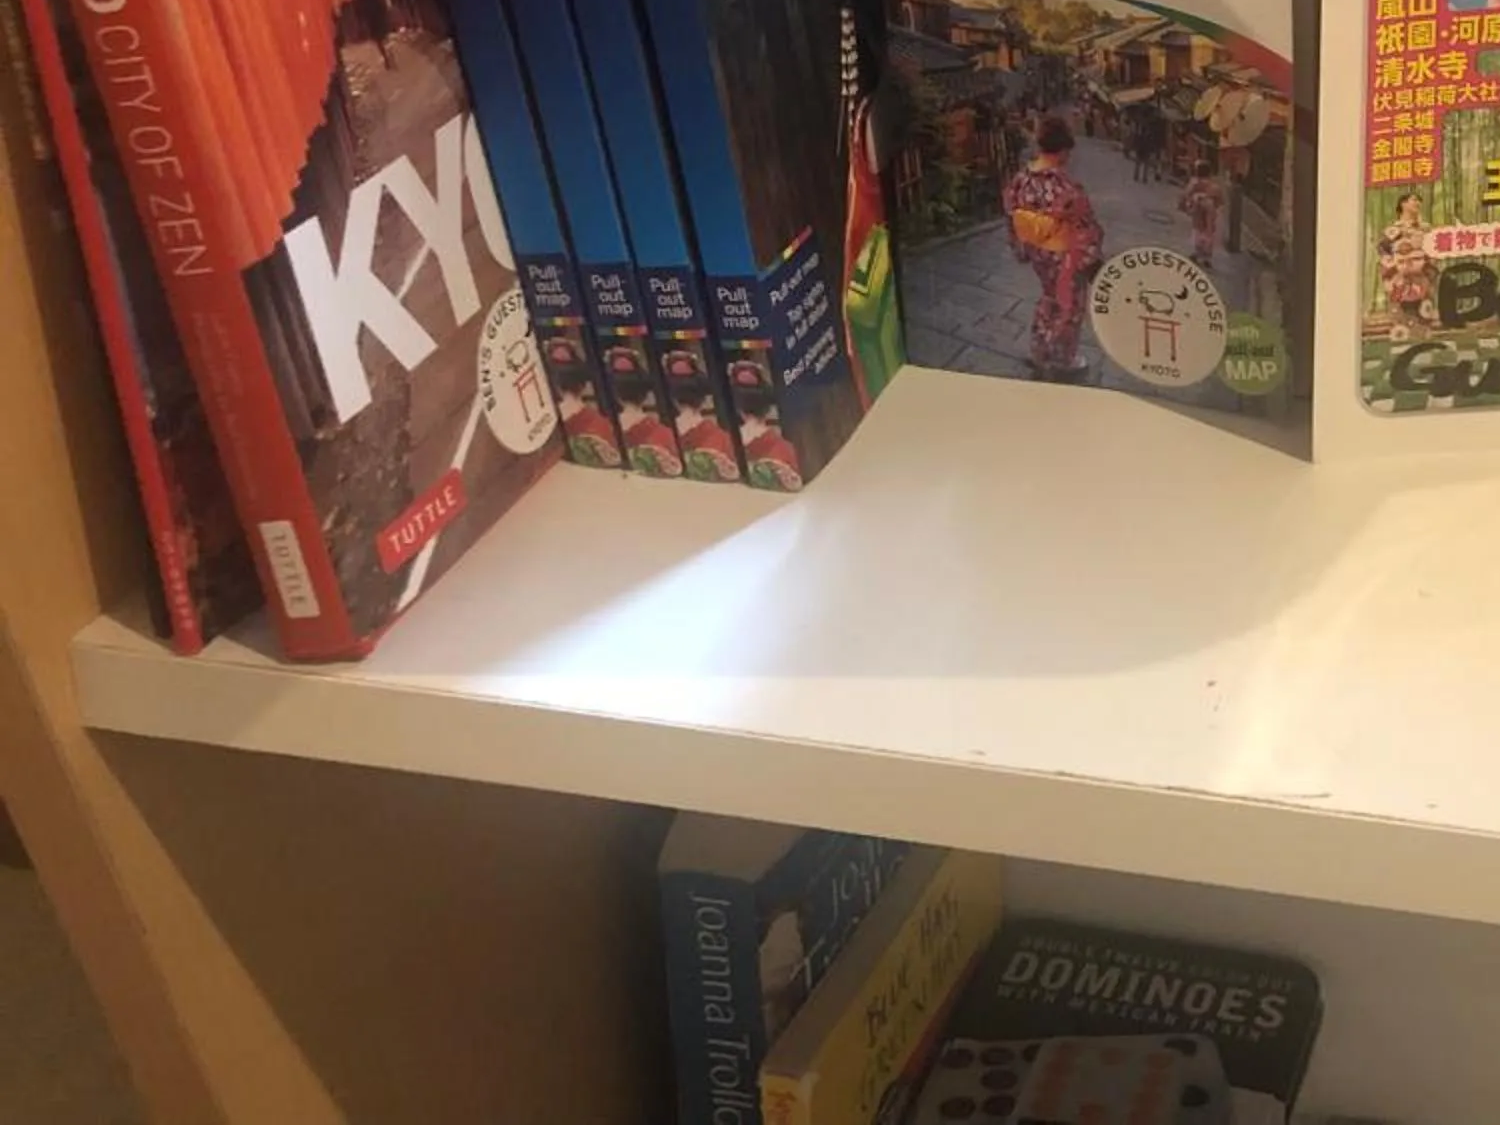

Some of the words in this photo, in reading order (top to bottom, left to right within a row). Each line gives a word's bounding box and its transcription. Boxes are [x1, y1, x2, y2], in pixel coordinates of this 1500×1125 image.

[99, 24, 162, 126] CITY
[1374, 50, 1469, 89] 清水寺
[1373, 81, 1500, 113] 伏見稲荷大社
[127, 124, 180, 181] OF
[1371, 133, 1436, 161] 金閣寺
[147, 193, 214, 278] ZEN
[535, 279, 562, 293] out
[535, 292, 571, 308] map
[599, 288, 625, 303] out
[658, 292, 685, 307] out
[1094, 264, 1122, 315] BEN'S
[1122, 250, 1224, 334] GUESTHOUSE
[598, 301, 633, 318] map
[657, 305, 694, 322] map
[725, 301, 752, 316] out
[722, 314, 760, 332] map
[1225, 359, 1278, 381] MAP
[387, 482, 459, 556] TUTTLE
[690, 894, 734, 1022] Joanna
[1001, 950, 1288, 1029] DOMINOES
